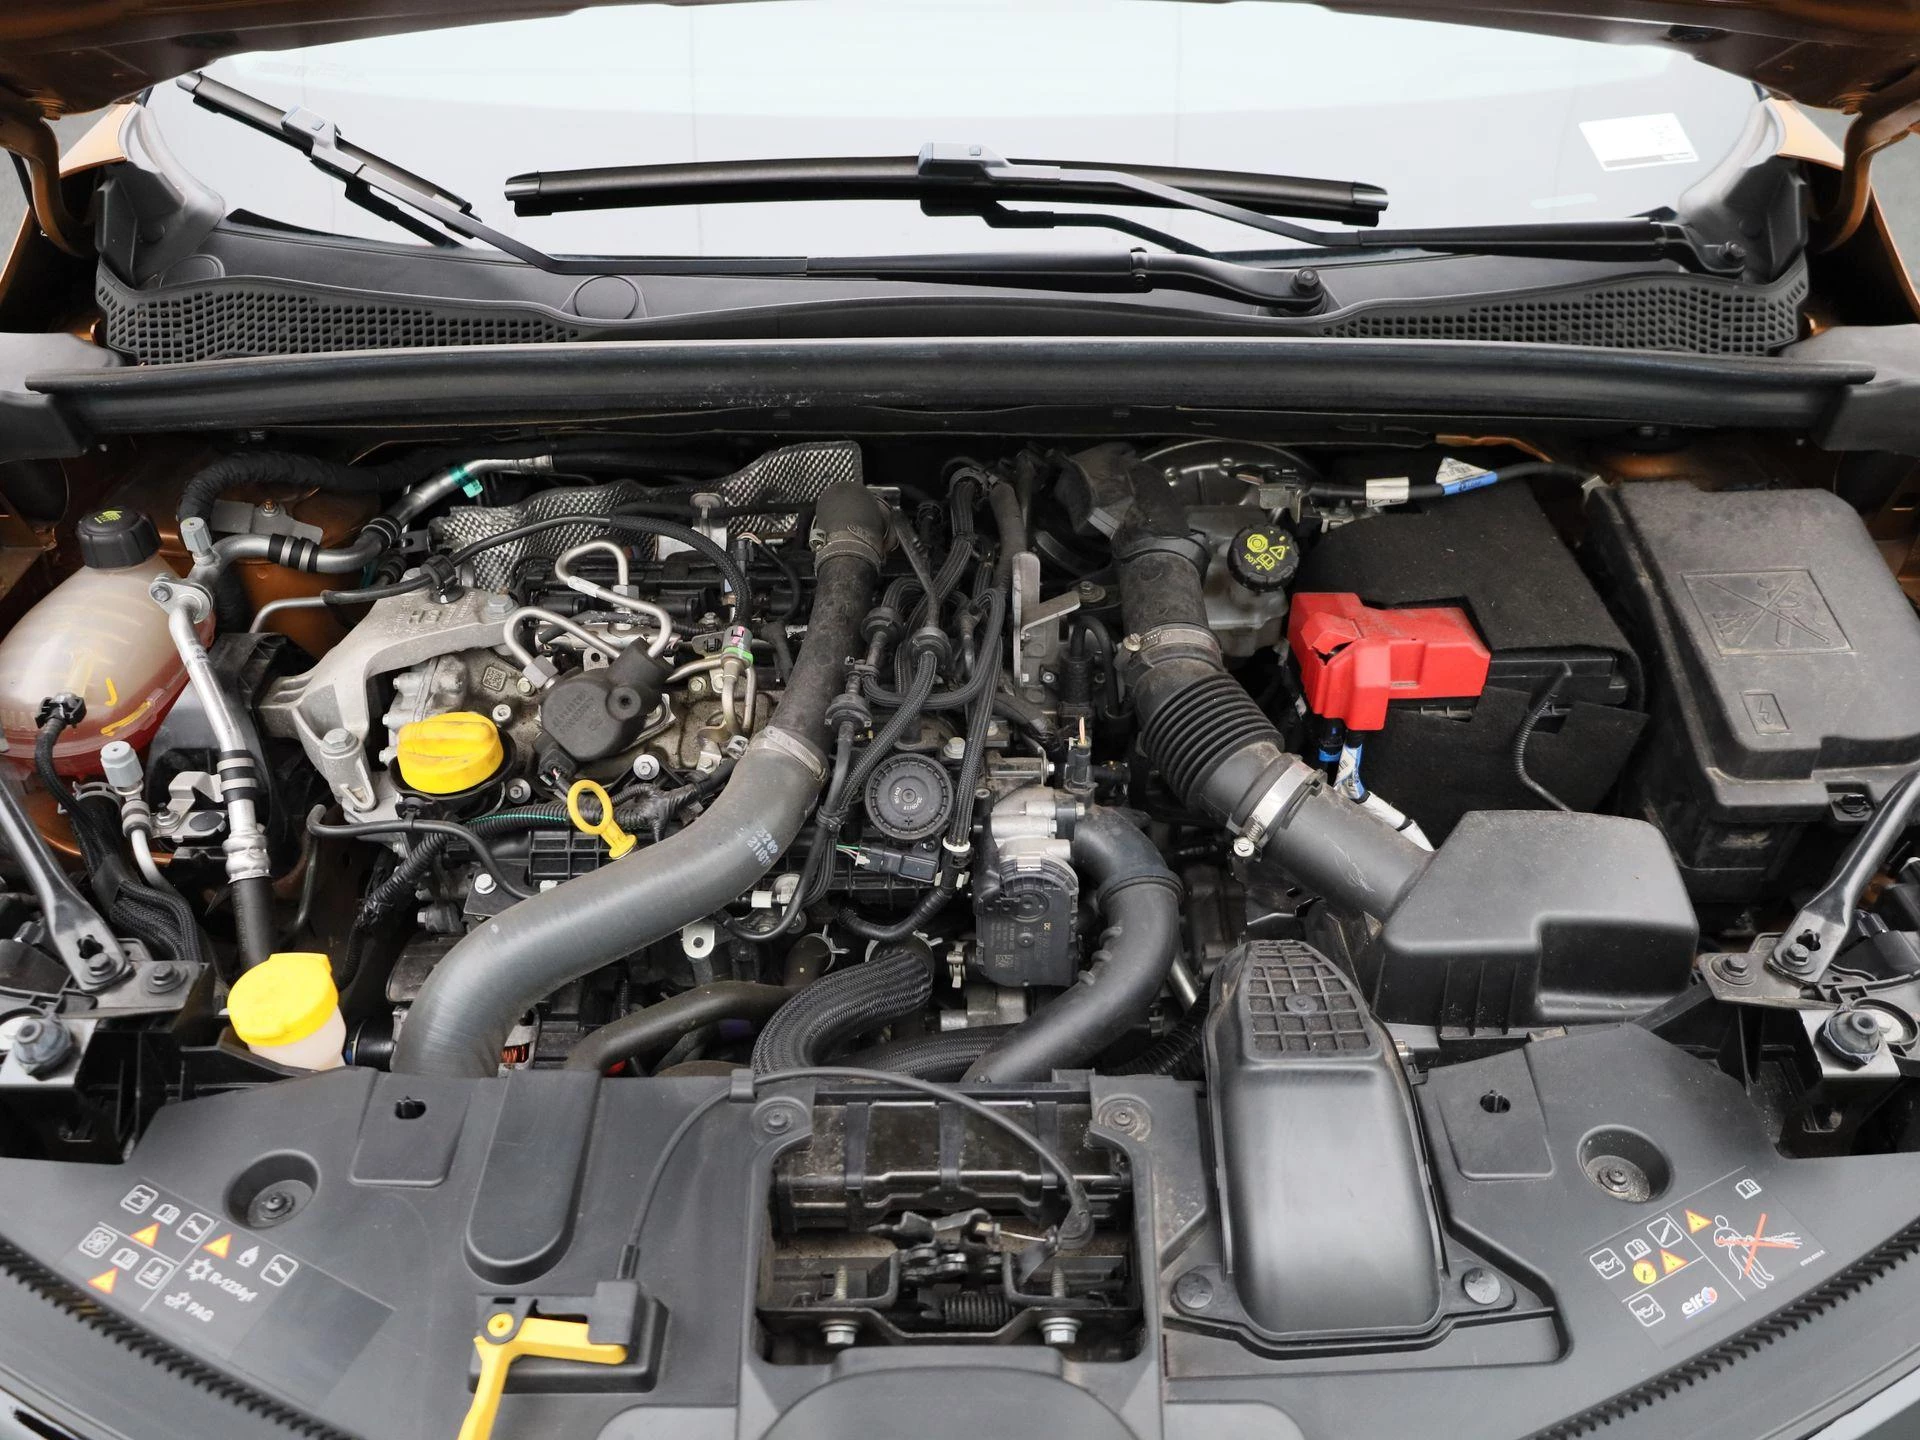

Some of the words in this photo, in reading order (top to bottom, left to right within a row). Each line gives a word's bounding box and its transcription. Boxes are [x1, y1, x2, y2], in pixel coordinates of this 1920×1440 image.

[1243, 553, 1258, 566] DOT
[184, 1301, 215, 1322] PAG
[1681, 1291, 1706, 1316] elf
